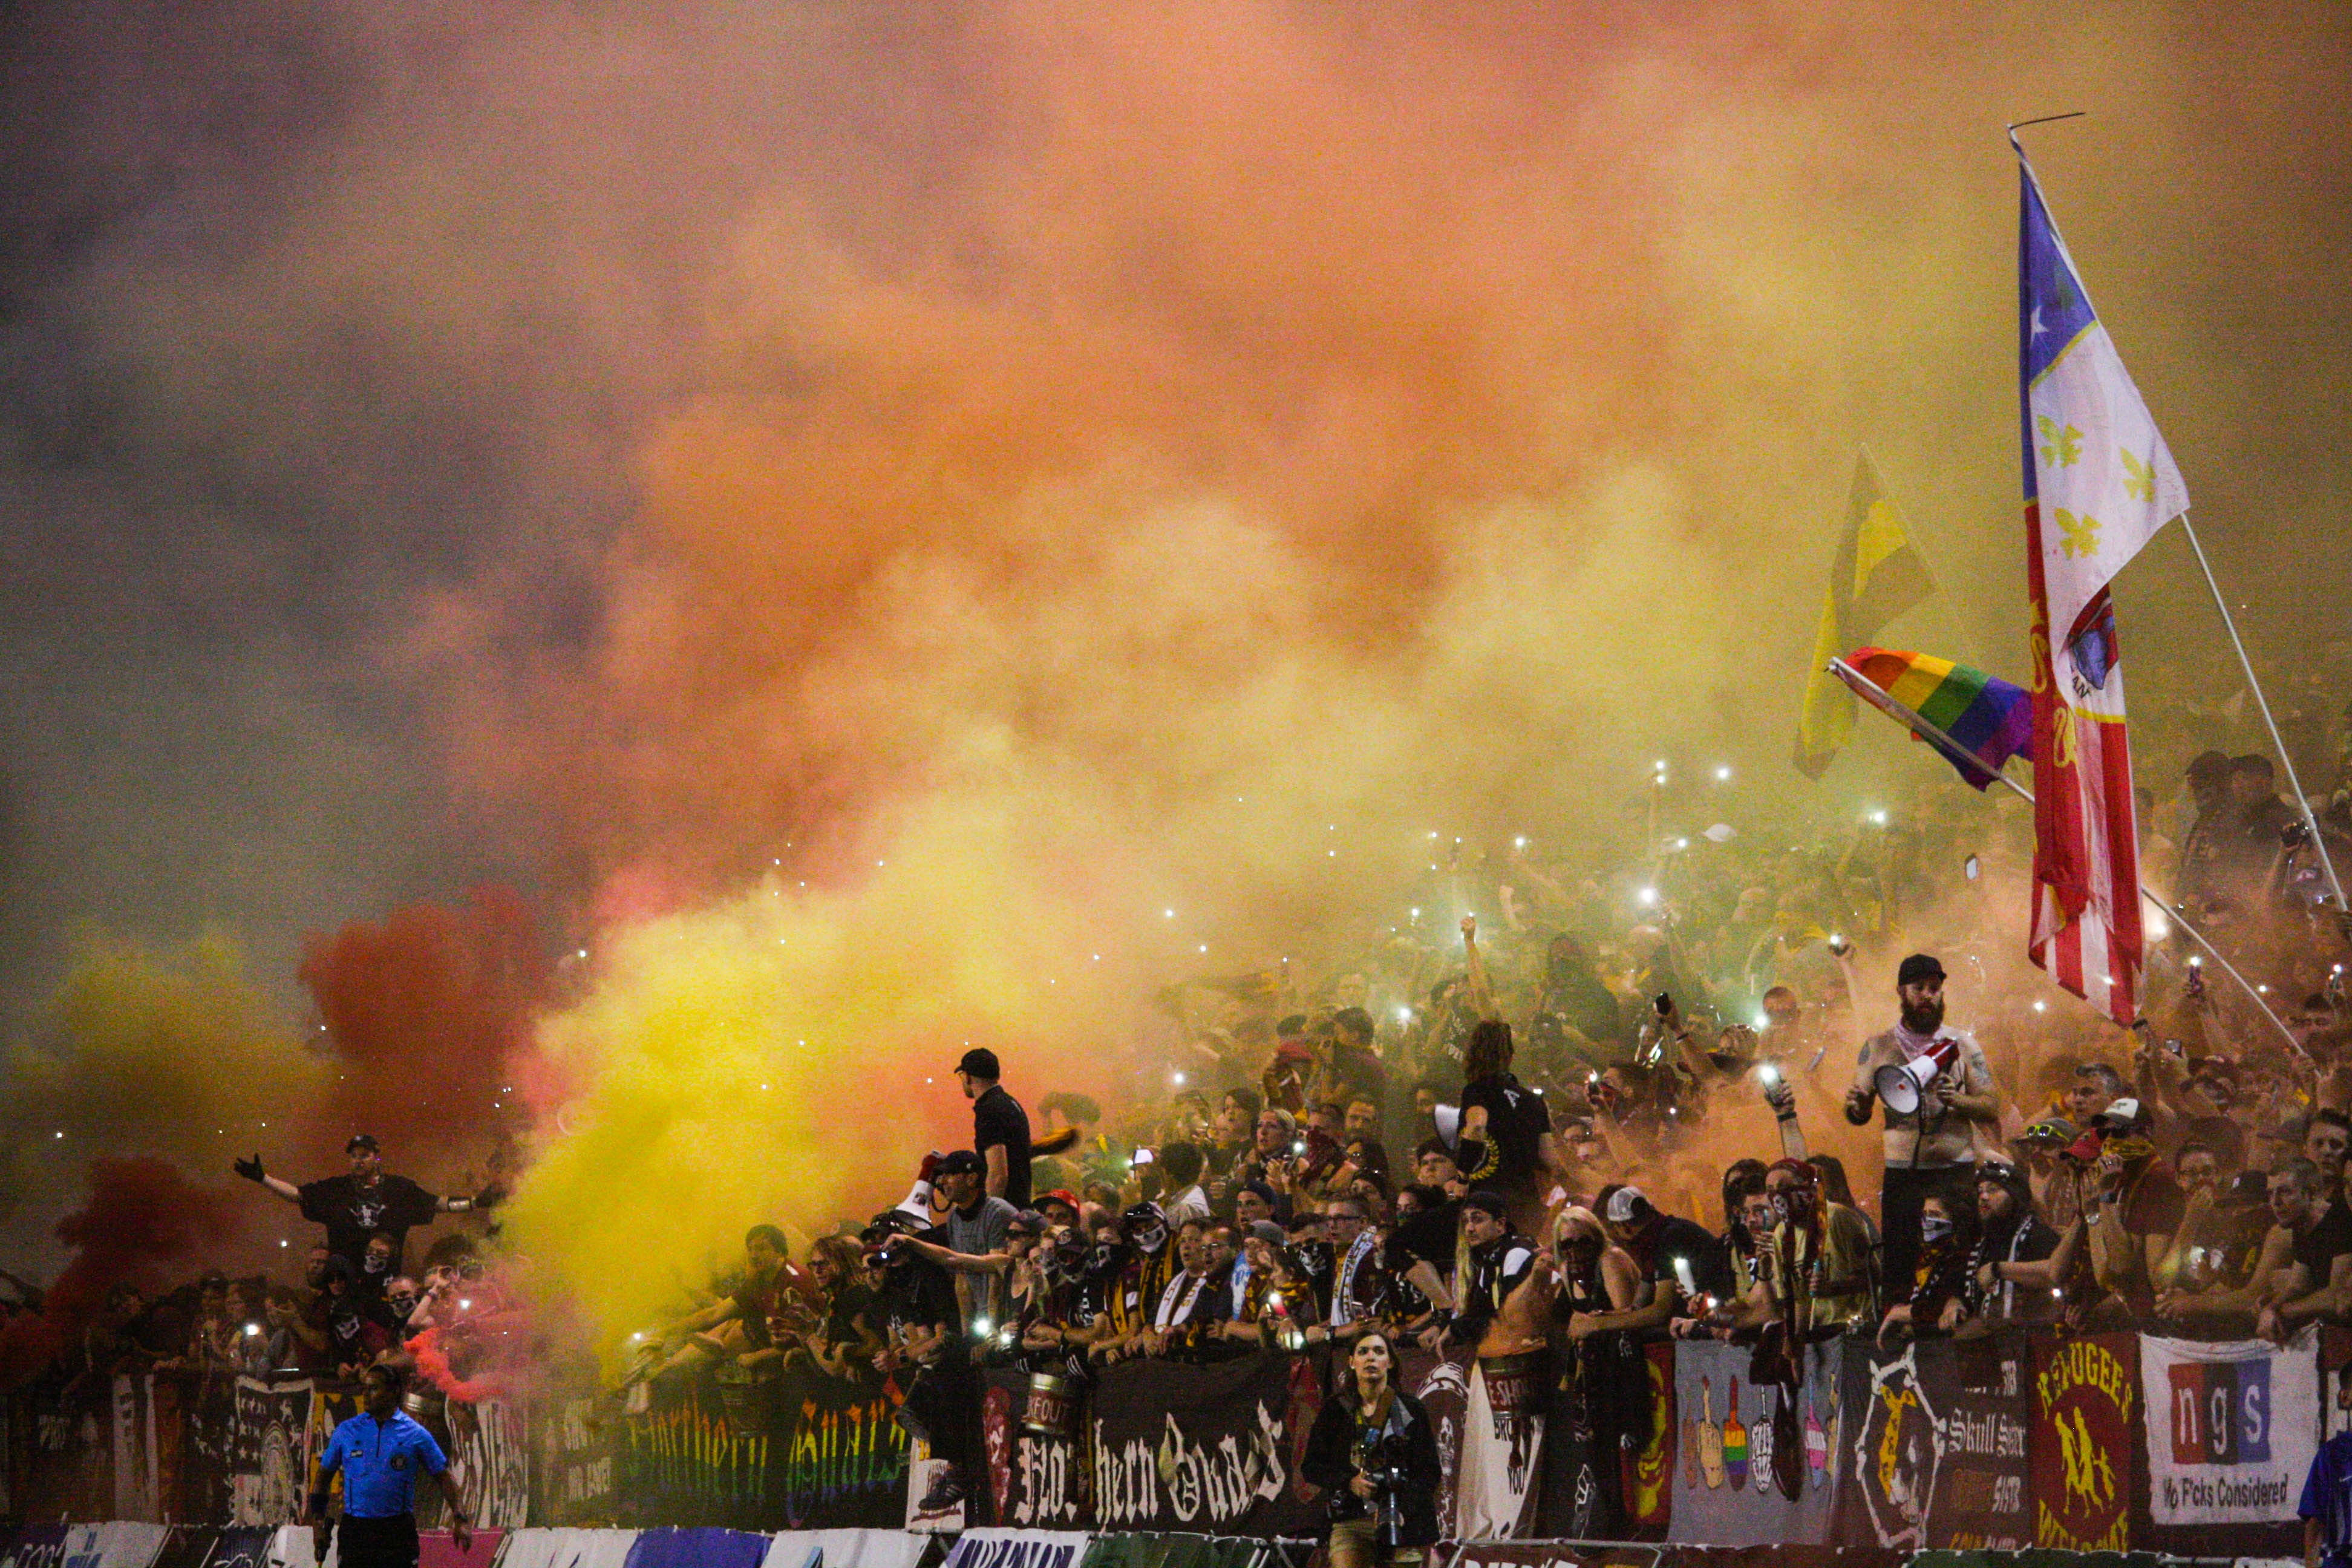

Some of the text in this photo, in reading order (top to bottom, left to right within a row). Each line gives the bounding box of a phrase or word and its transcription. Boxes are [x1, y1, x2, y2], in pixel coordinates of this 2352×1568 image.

[2036, 1342, 2133, 1425] REFUGEES
[1948, 1407, 1996, 1453] Skull
[2178, 1384, 2262, 1455] ngs
[1014, 1417, 1159, 1533] Nohern
[2216, 1473, 2288, 1508] Considered
